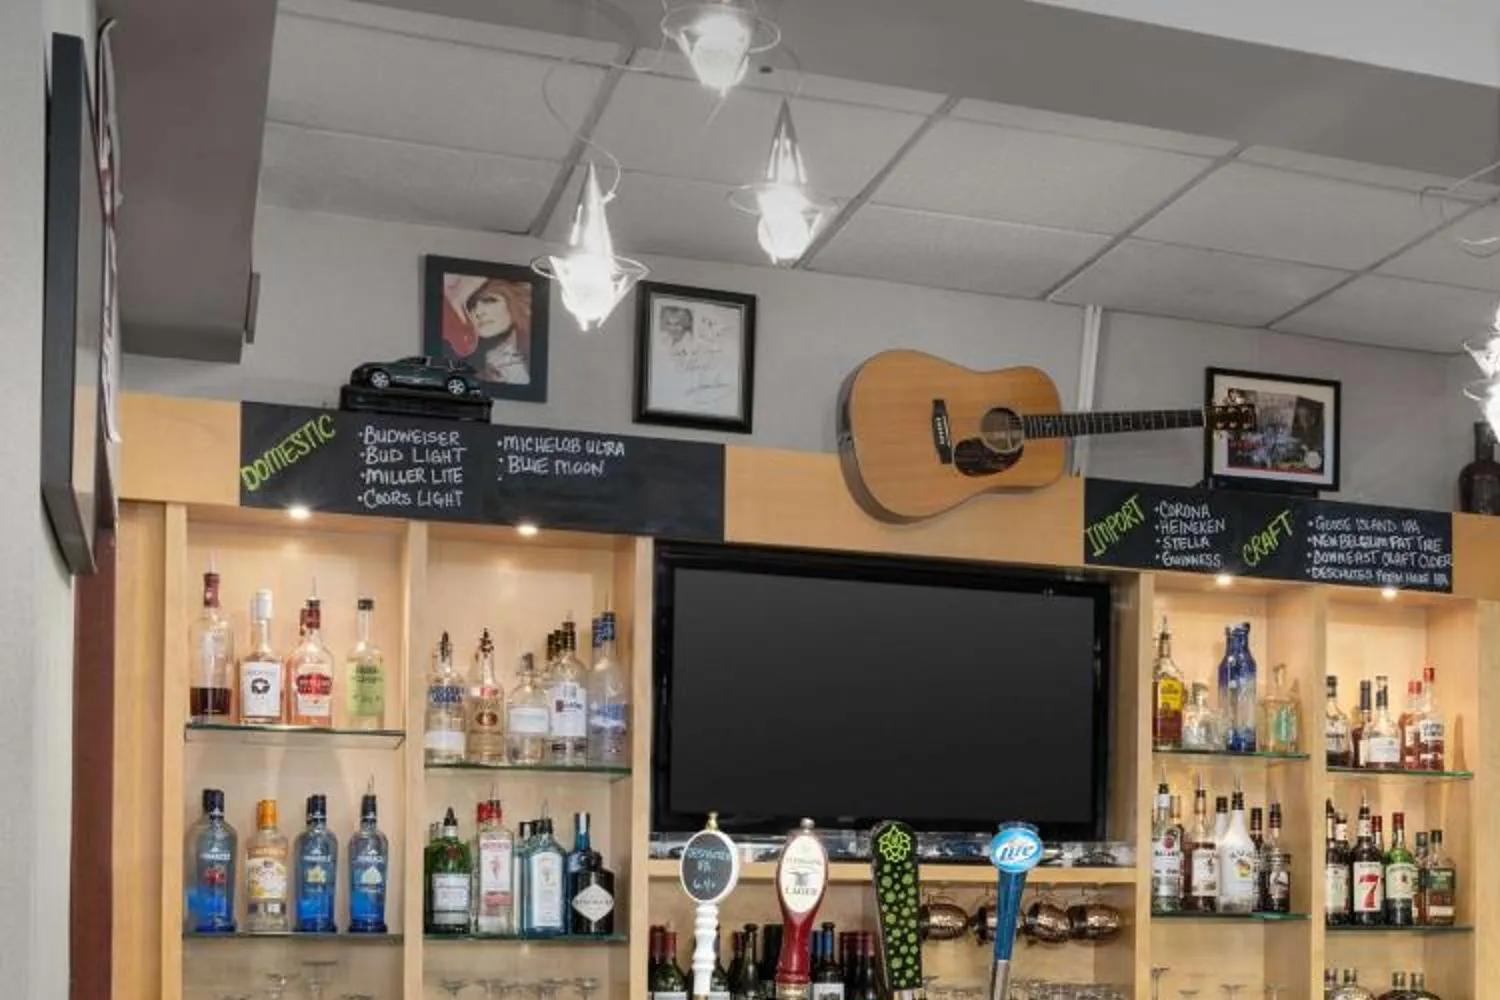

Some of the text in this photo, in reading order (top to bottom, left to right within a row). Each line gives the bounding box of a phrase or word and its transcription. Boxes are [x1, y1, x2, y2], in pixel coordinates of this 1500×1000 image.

[364, 425, 460, 446] BUDWEISER
[503, 435, 581, 453] MICHELOB
[241, 414, 336, 491] DOMESTIC
[366, 446, 467, 465] BUD LIGHT
[508, 455, 605, 475] BLUE MOON
[366, 467, 463, 484] MILLER LITE
[364, 489, 464, 508] COORS LIGHT
[1159, 501, 1211, 519] CORONA
[1086, 493, 1145, 557] IMPORT
[1160, 518, 1226, 535] HEINEKEN
[1356, 517, 1397, 533] ISLAND
[1163, 536, 1210, 550] STELLA
[1242, 510, 1294, 567] CRAFT
[1161, 551, 1221, 568] GUINNESS
